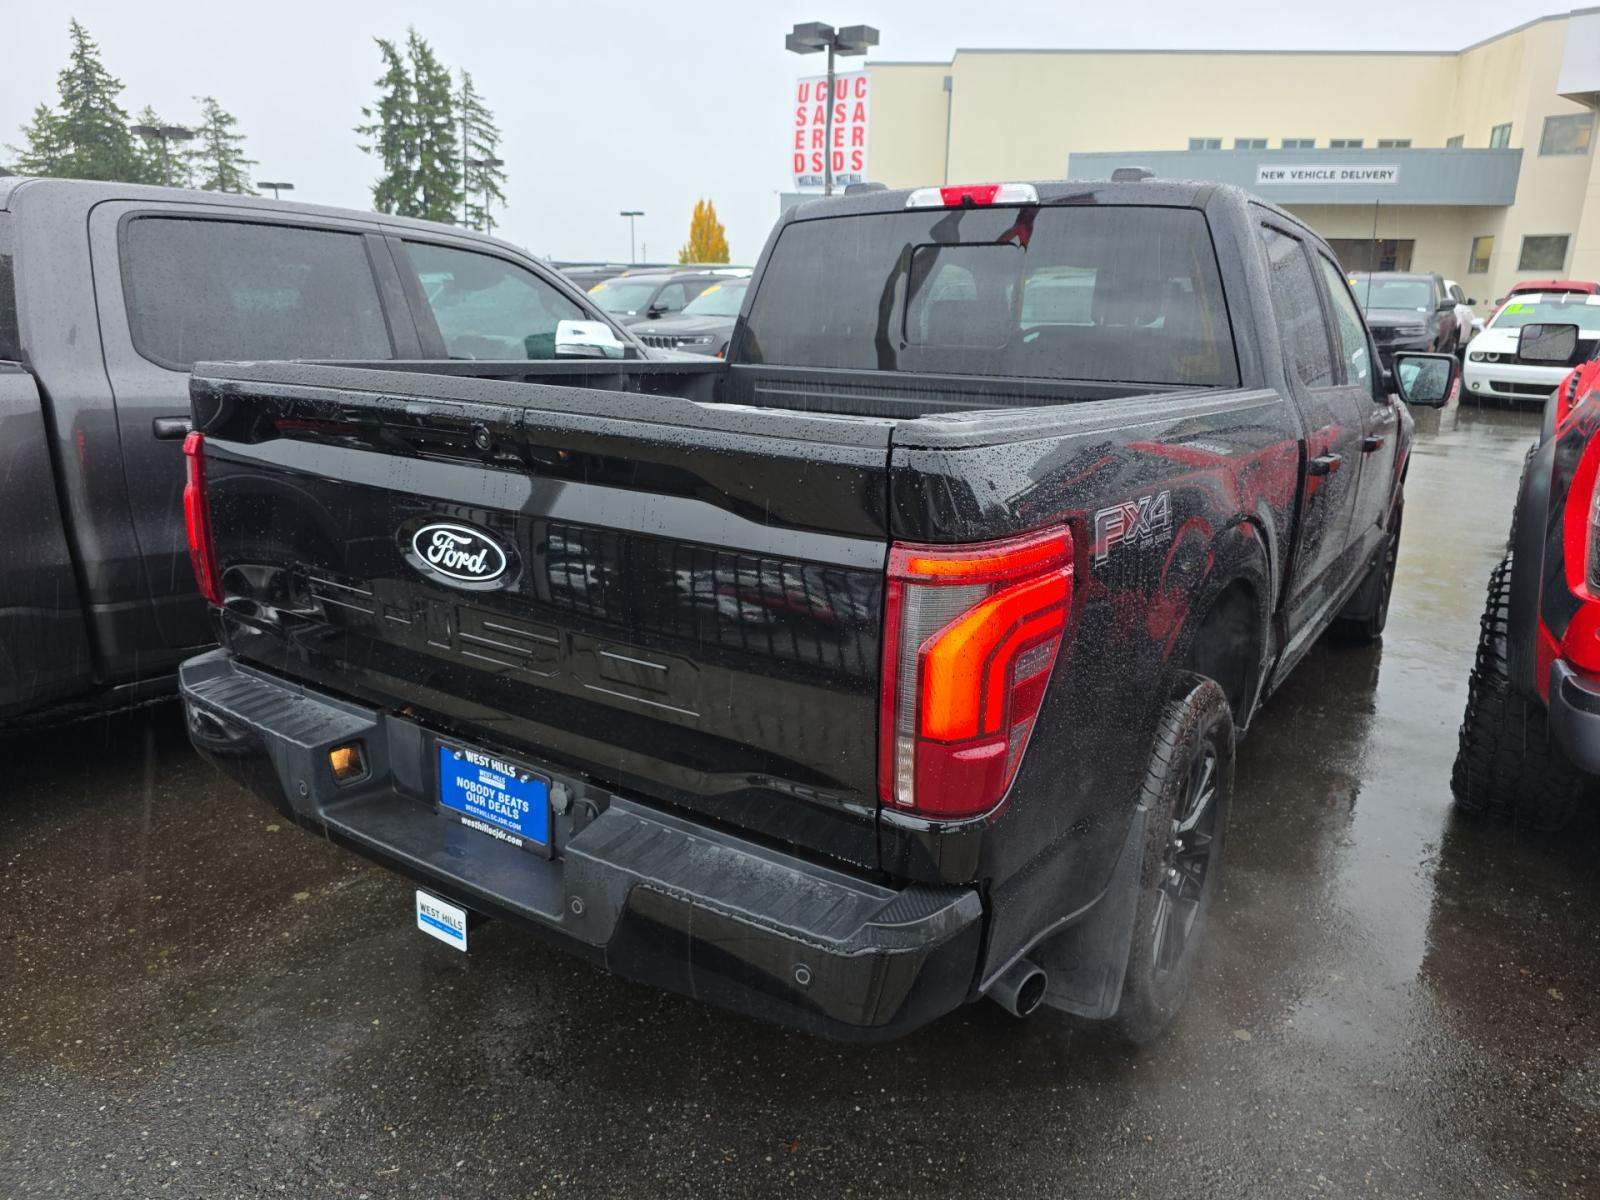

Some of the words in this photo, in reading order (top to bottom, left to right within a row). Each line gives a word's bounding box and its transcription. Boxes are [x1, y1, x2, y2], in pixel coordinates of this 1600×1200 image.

[1261, 171, 1285, 180] NEW
[1291, 170, 1336, 180] VEHICLE
[1341, 170, 1394, 180] DELIVERY
[1095, 490, 1172, 568] FX4
[427, 530, 488, 574] Ford
[464, 750, 490, 767] WEST
[491, 760, 516, 778] HILLS
[479, 769, 493, 779] WEST
[492, 774, 506, 785] HILLS
[456, 776, 495, 799] NOBODY
[498, 792, 529, 813] BEATS
[465, 791, 486, 807] OUR
[488, 799, 519, 819] DEALS
[420, 901, 440, 918] WEST
[442, 913, 463, 931] HILLS
